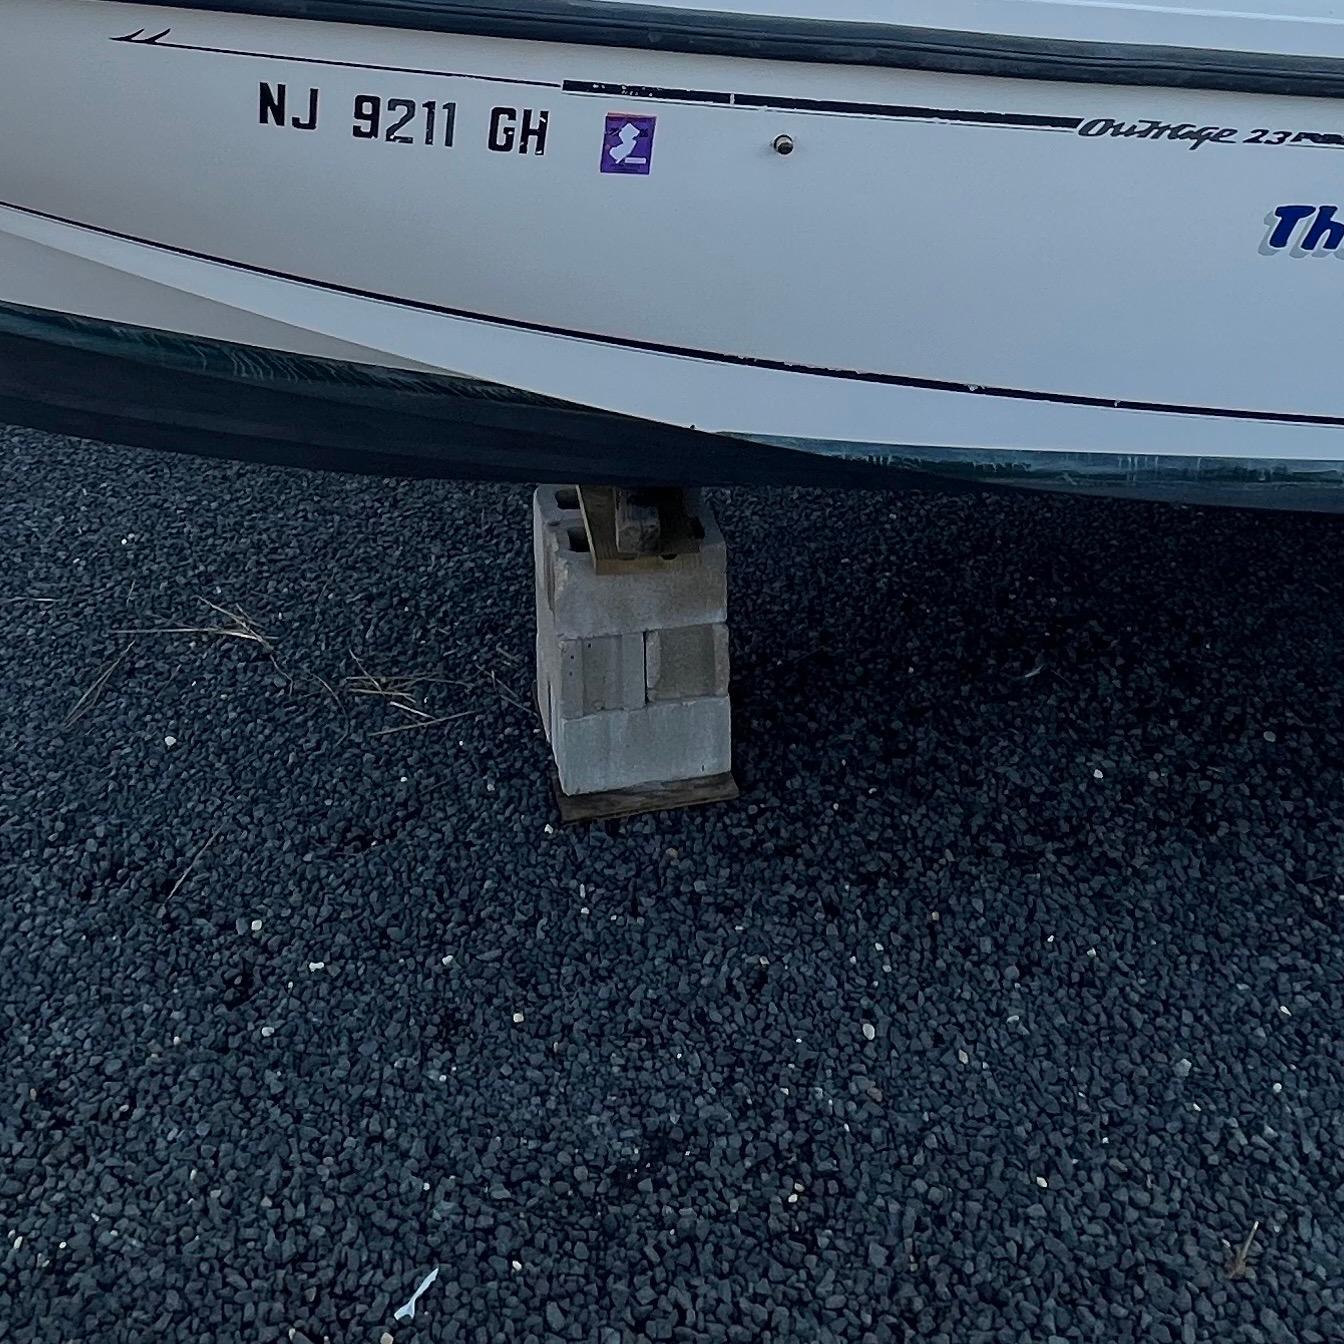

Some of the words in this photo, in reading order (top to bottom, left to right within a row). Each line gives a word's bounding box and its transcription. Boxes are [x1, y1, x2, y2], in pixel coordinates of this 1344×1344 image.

[259, 81, 320, 131] NJ
[352, 94, 457, 147] 9211
[487, 106, 549, 156] GH
[1078, 118, 1238, 150] Outrage
[1243, 129, 1293, 144] 23
